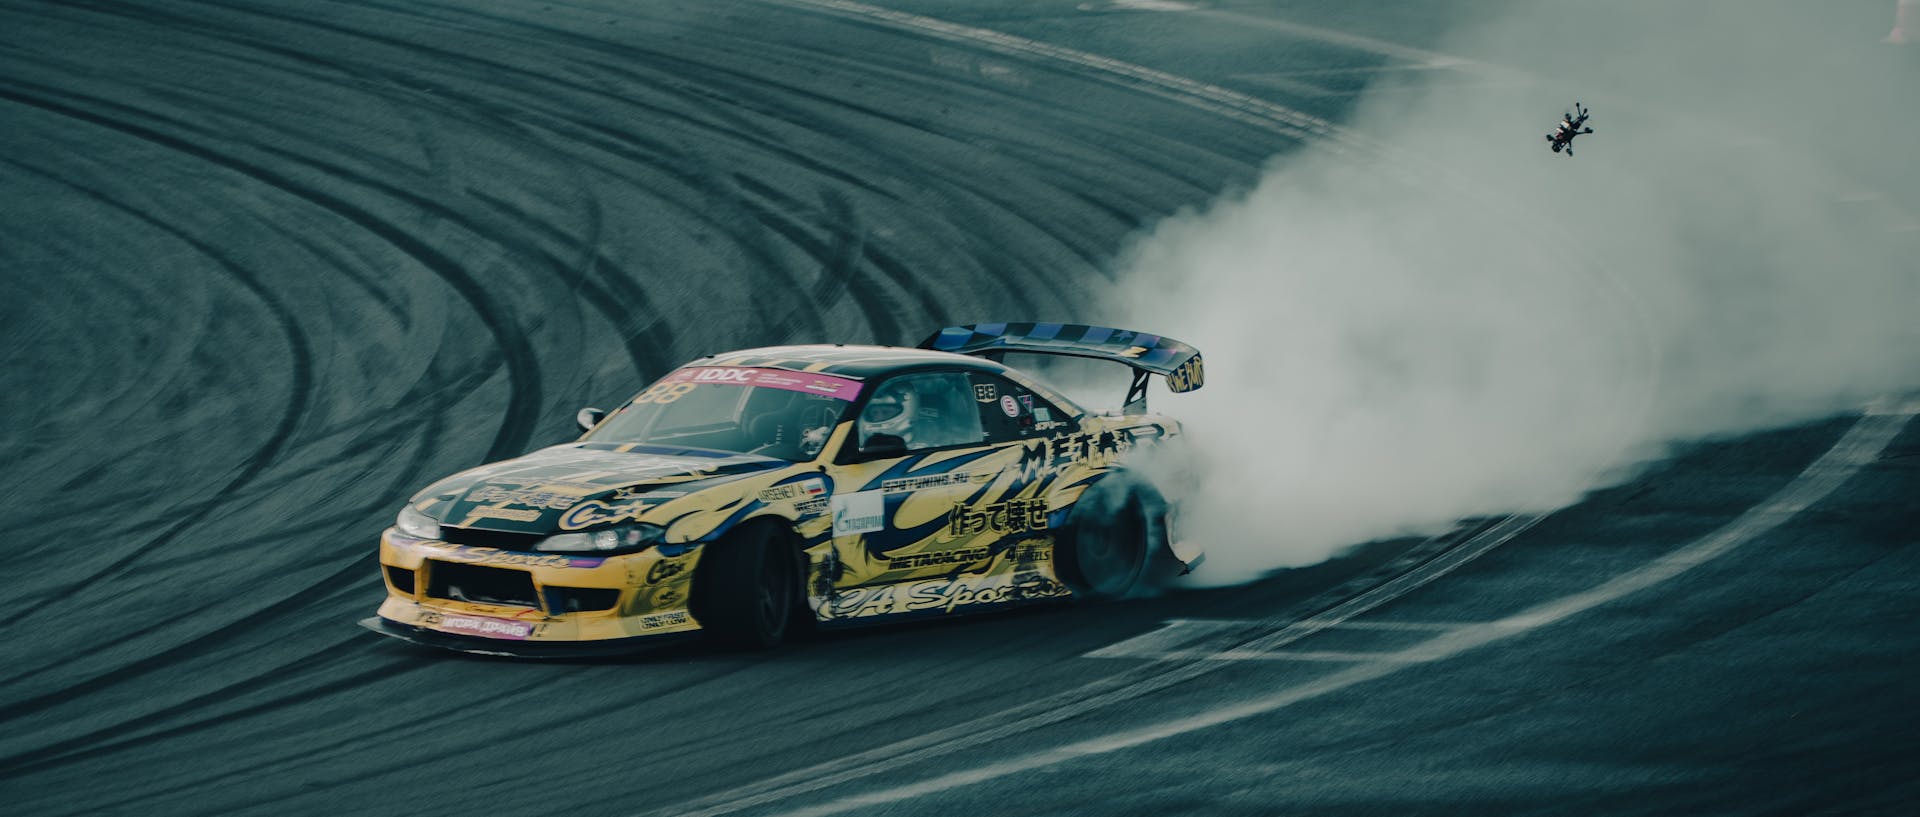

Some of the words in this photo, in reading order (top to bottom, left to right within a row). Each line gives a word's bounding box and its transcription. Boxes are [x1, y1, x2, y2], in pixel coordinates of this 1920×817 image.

[694, 369, 757, 381] IDDC
[974, 385, 997, 400] 88
[949, 498, 1049, 538] 作って壊せ
